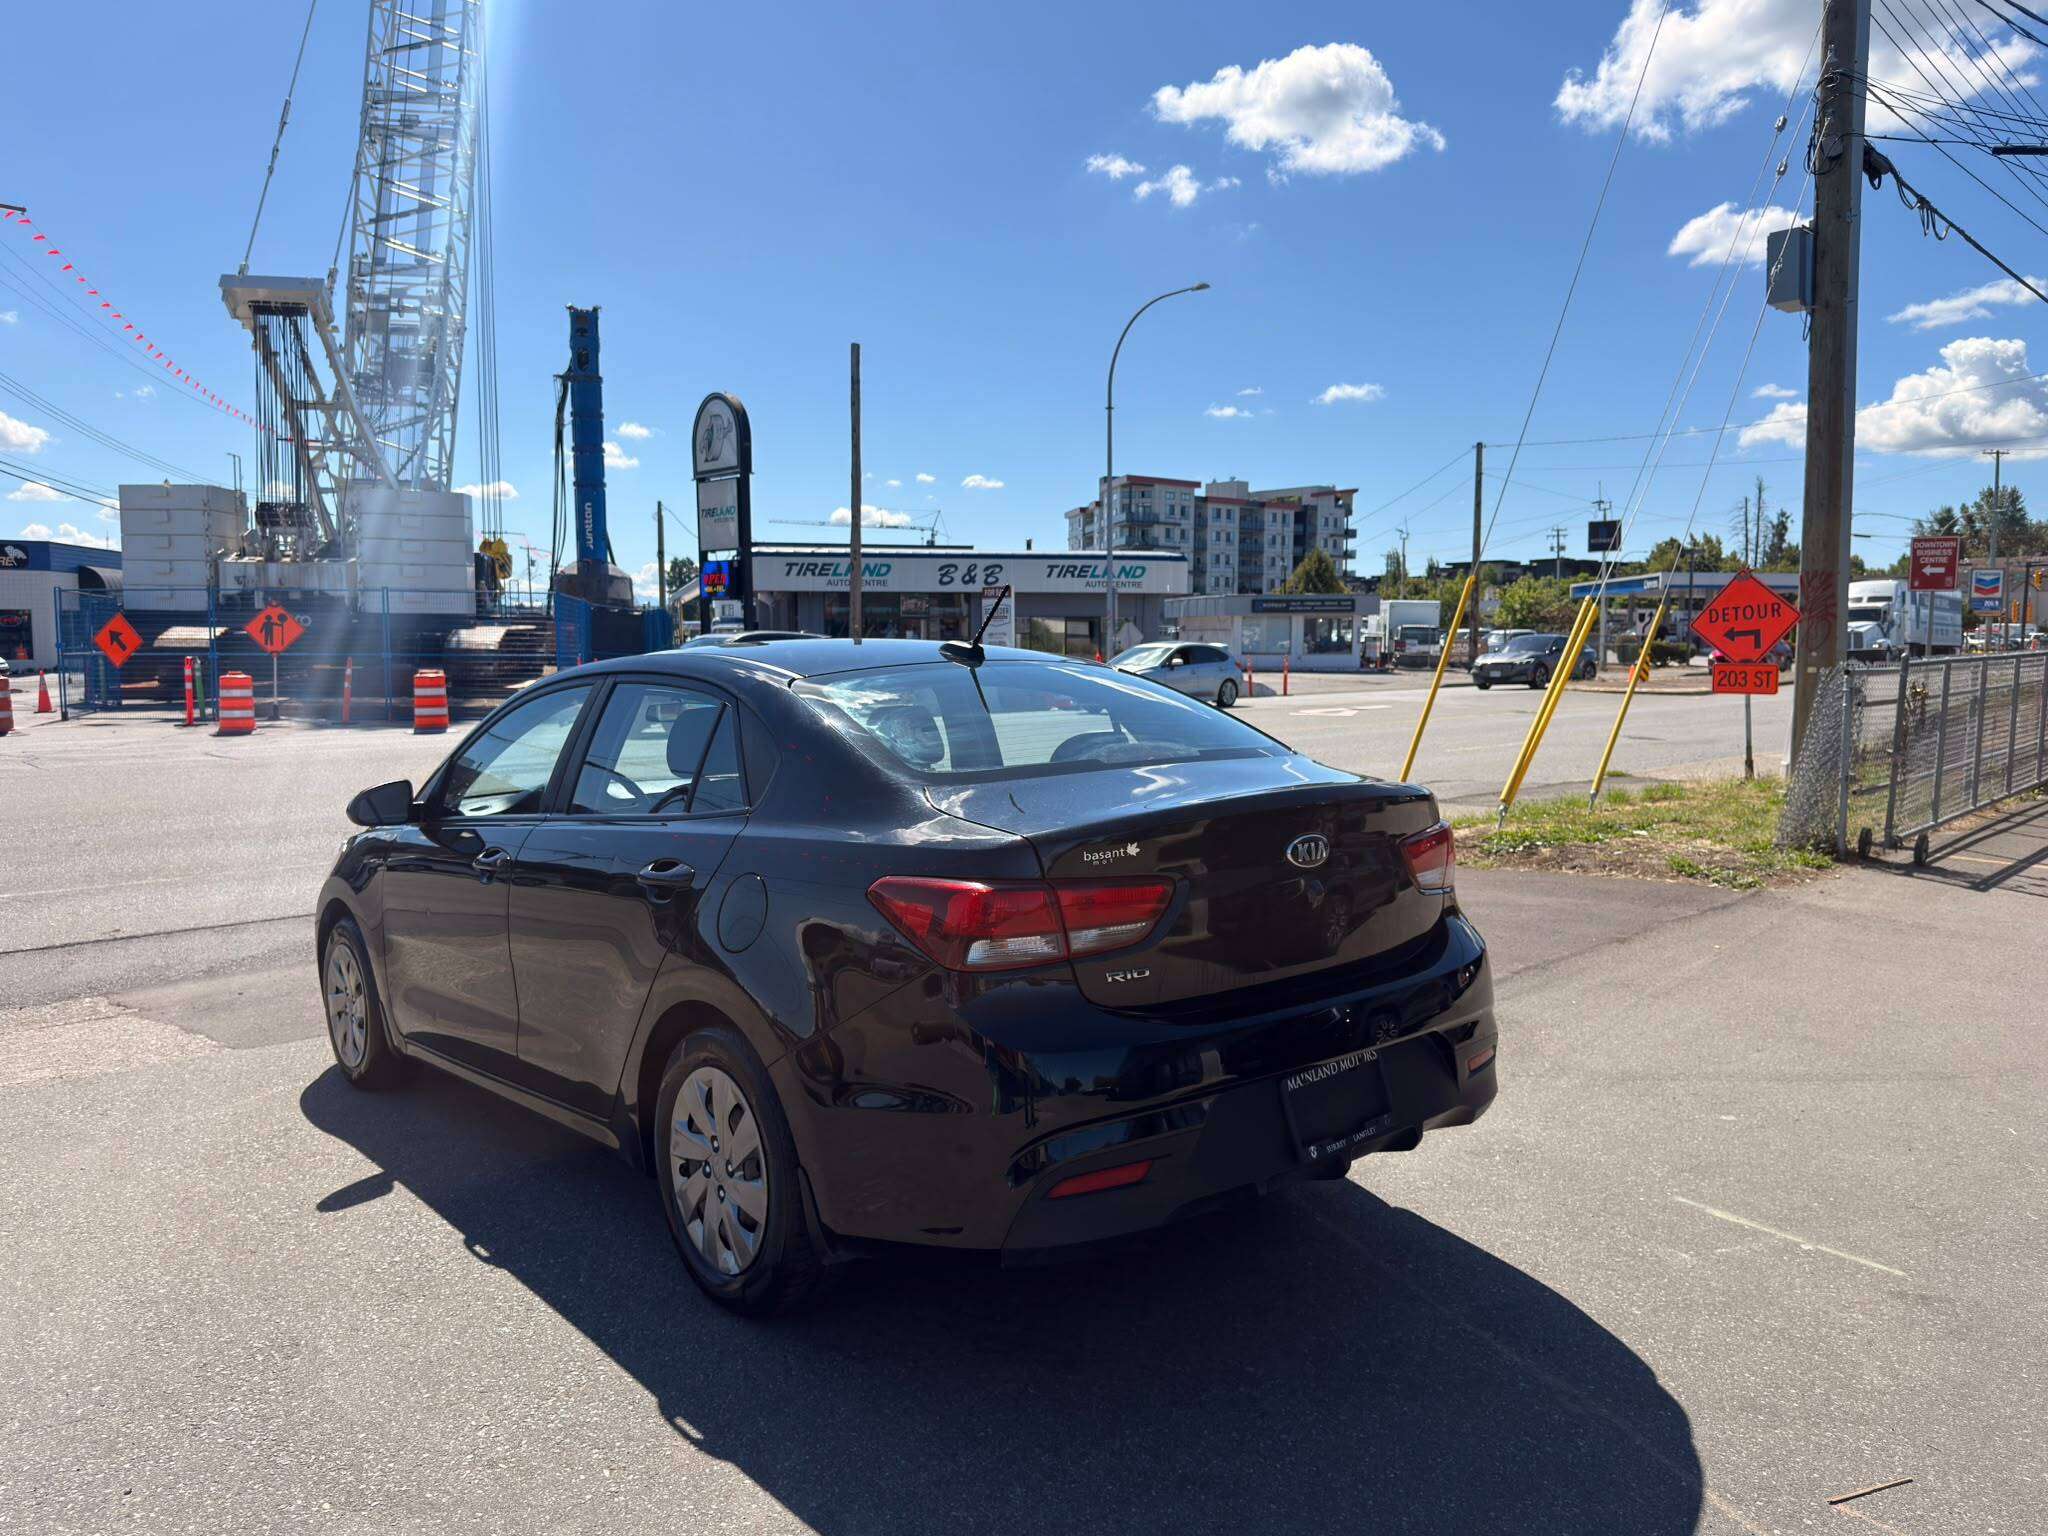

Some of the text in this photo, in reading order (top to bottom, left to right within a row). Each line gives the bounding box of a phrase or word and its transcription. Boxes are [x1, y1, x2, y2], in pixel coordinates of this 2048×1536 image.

[1914, 541, 1956, 549] DOWNTOWN
[1920, 556, 1948, 564] CENTRE
[938, 563, 1004, 586] B & B
[1046, 564, 1147, 579] TIRELAND
[1085, 580, 1108, 589] AUTO
[1709, 602, 1781, 624] DETOUR
[1717, 670, 1773, 689] 203 ST
[1083, 848, 1125, 862] basant
[1105, 967, 1150, 982] RIO
